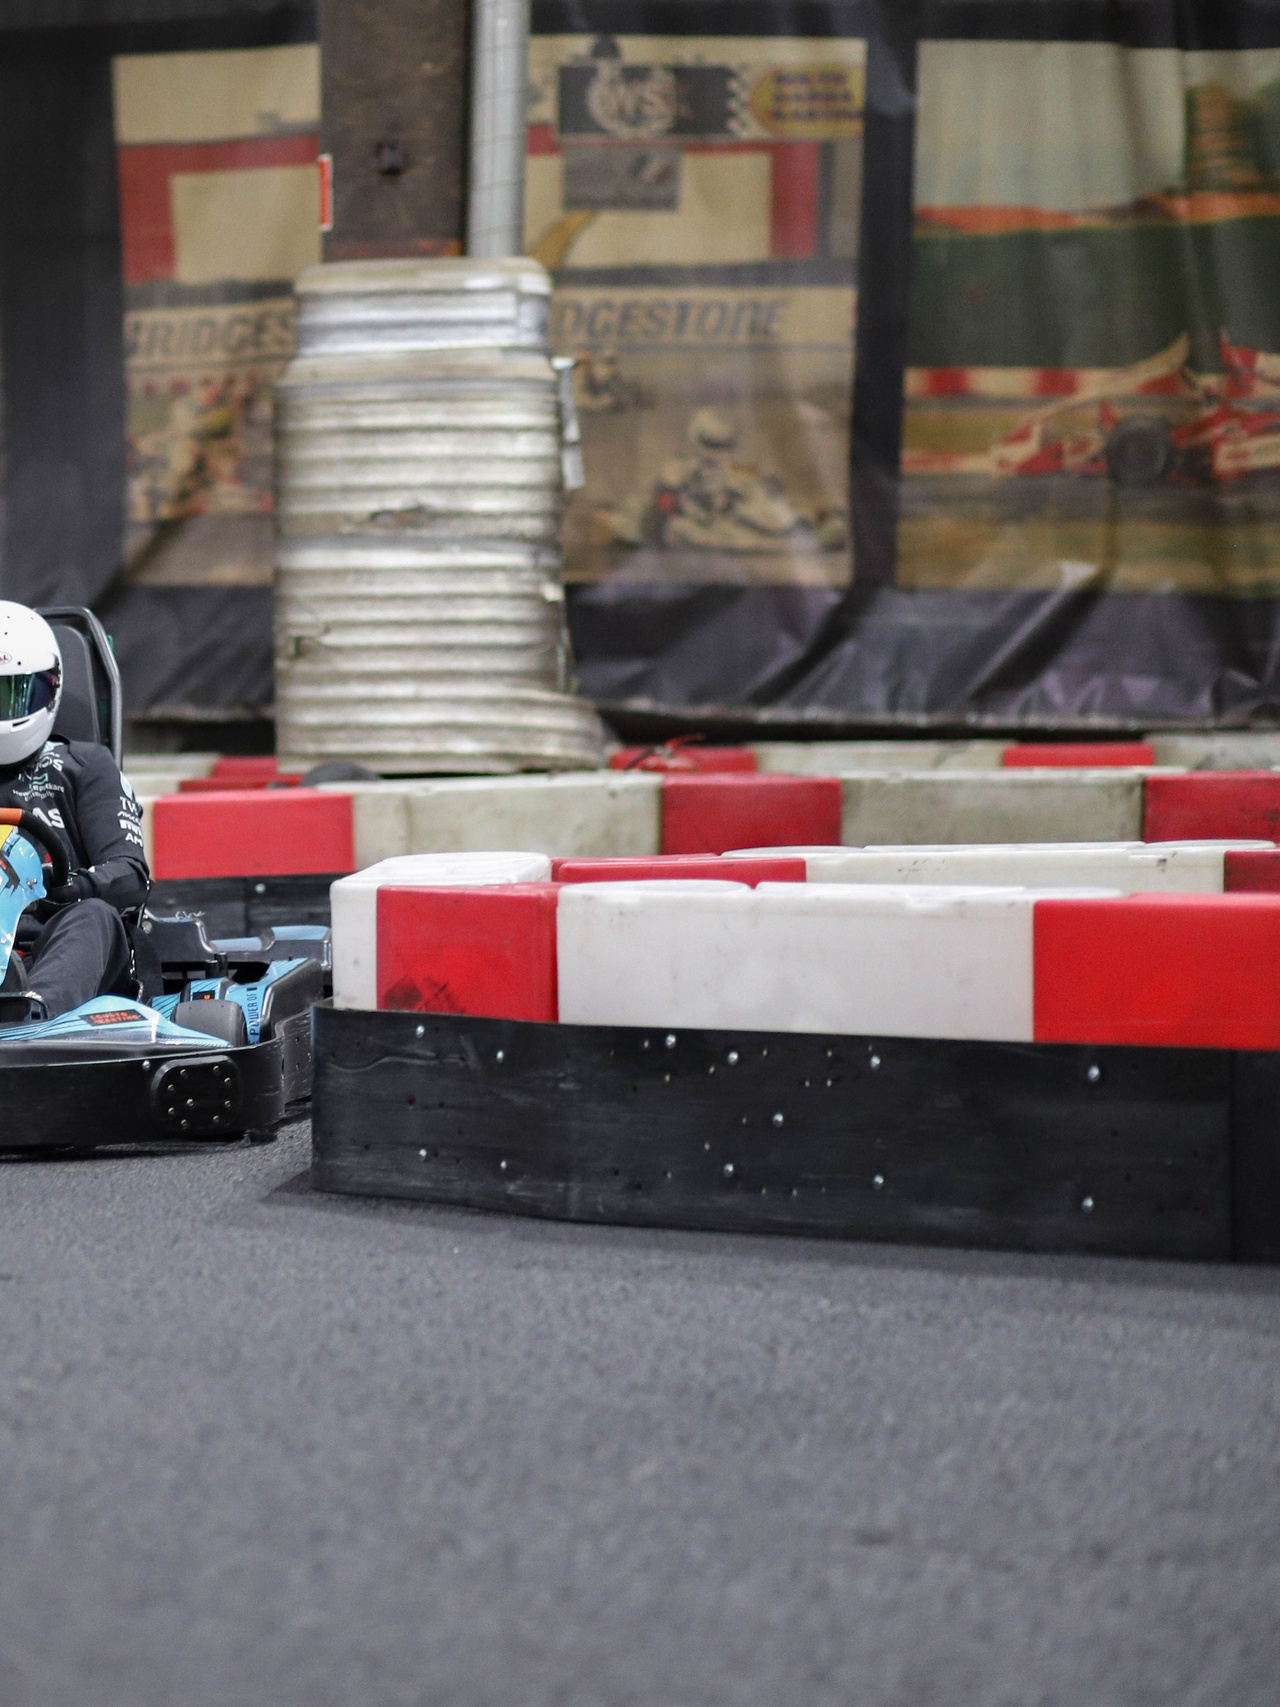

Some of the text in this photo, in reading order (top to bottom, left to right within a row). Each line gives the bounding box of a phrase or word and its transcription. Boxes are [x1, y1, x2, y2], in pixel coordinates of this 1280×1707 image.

[124, 311, 296, 357] BRIDGES
[558, 300, 788, 340] DGESTONE
[125, 832, 143, 847] AM
